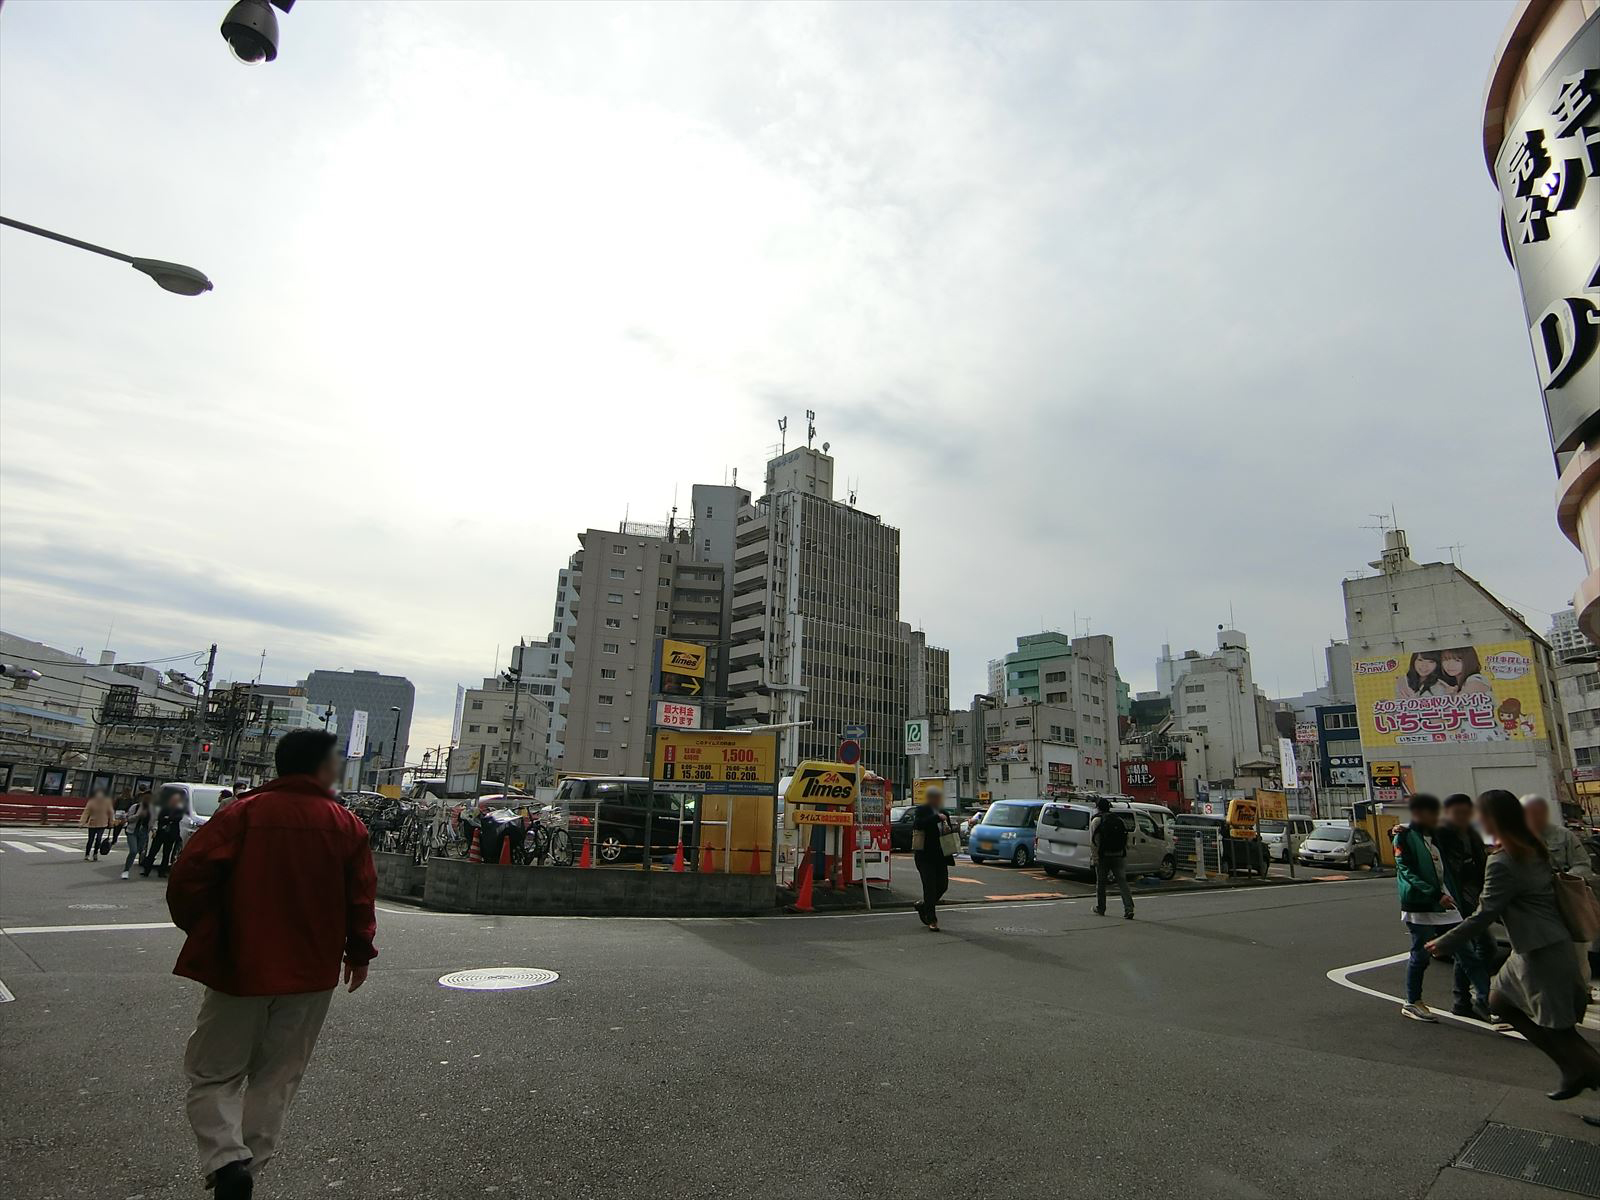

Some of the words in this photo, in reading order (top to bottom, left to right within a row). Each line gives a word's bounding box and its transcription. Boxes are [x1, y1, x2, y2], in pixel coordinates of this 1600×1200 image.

[671, 651, 701, 667] Times
[664, 704, 694, 717] 最大料金
[1374, 693, 1489, 714] 女の子の高収入バイト
[663, 714, 694, 726] あります
[1374, 705, 1494, 734] いちごナビ
[801, 770, 856, 798] Times
[1127, 774, 1155, 784] ホルモン
[1391, 777, 1399, 785] P
